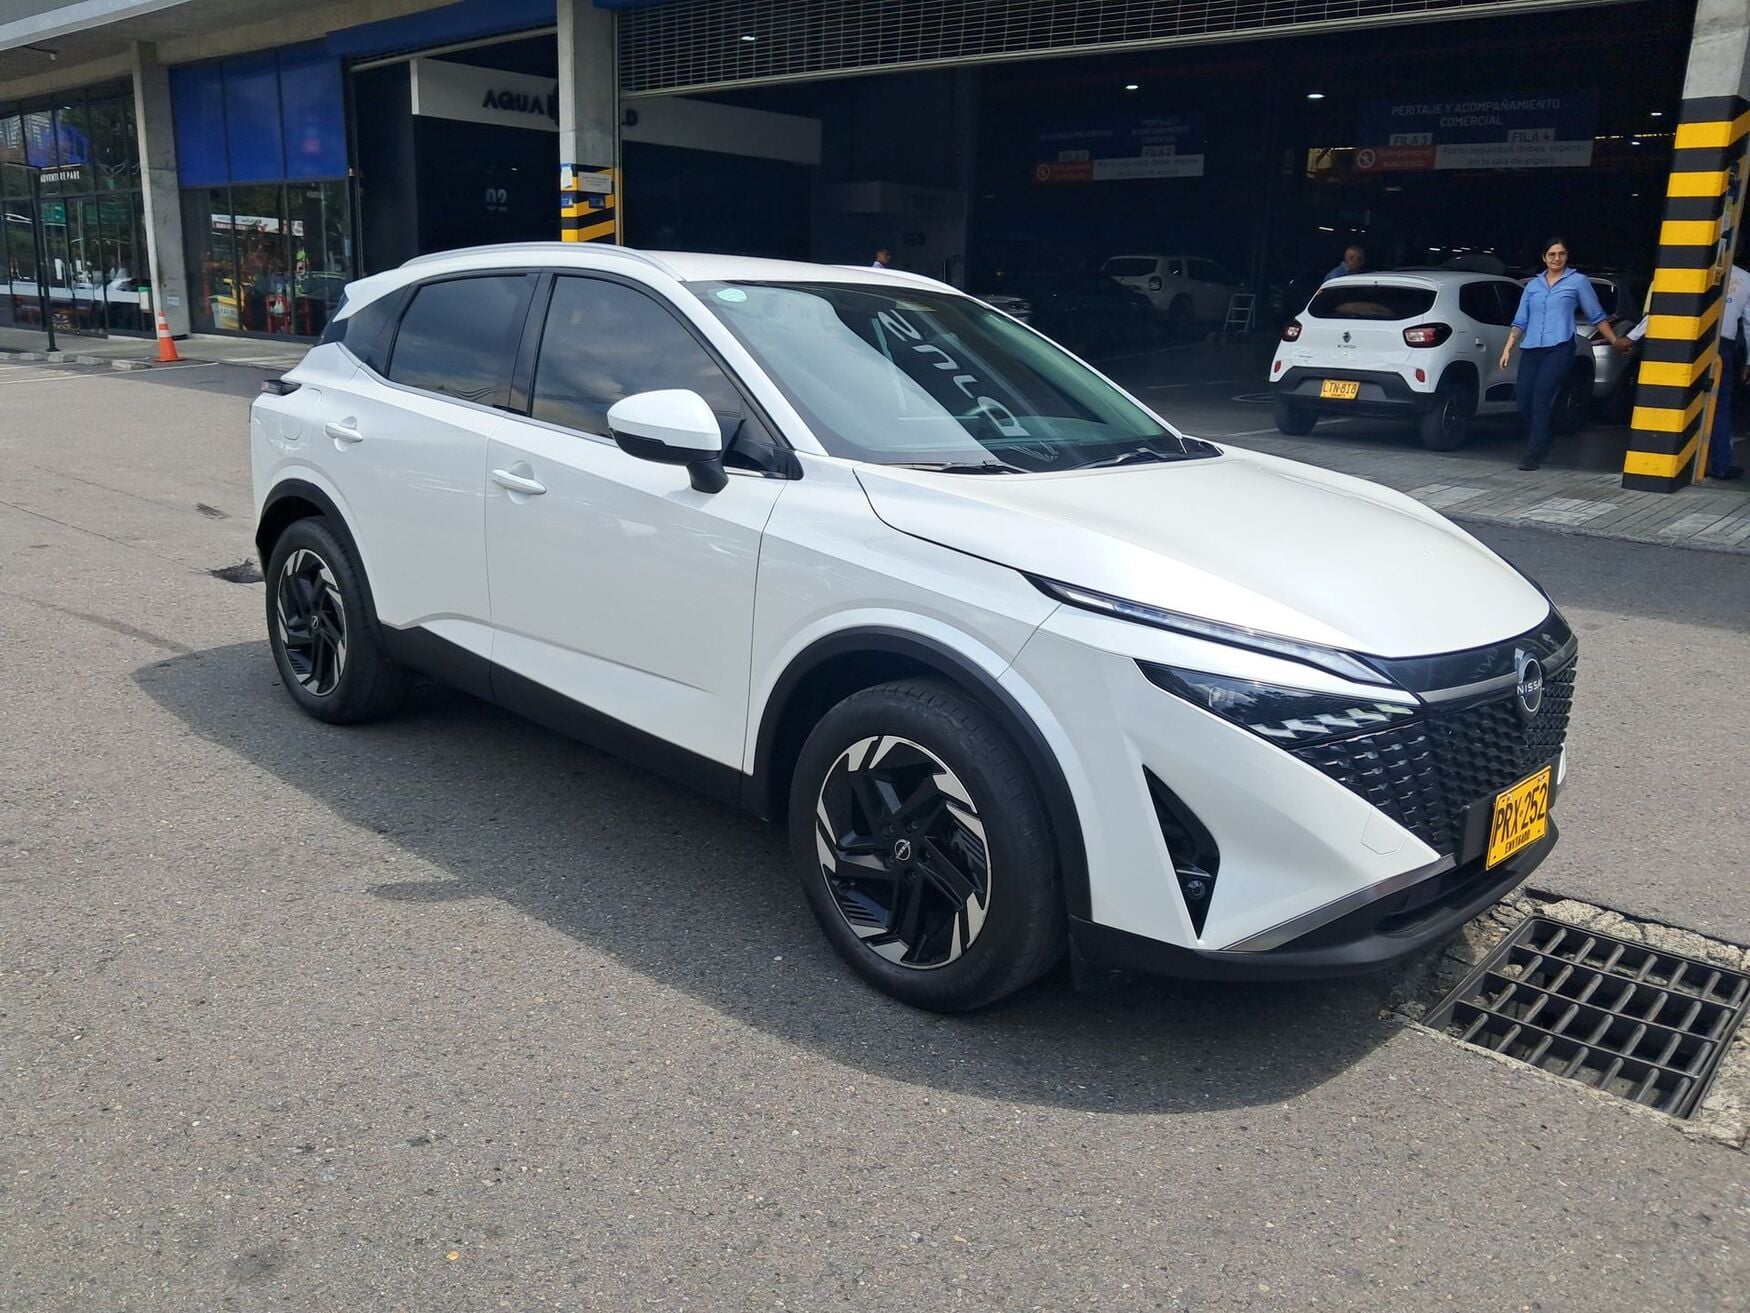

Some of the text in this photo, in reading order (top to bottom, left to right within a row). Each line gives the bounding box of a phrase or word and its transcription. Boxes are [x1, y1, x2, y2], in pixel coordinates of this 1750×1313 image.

[482, 89, 545, 115] AQUA
[1391, 103, 1443, 116] PERITAJE
[1454, 97, 1560, 114] ACOMPAÑAMIENTO
[1439, 115, 1503, 128] COMERCIAL
[1393, 135, 1418, 145] FILA
[1512, 132, 1539, 143] FILA
[66, 170, 80, 180] PARK
